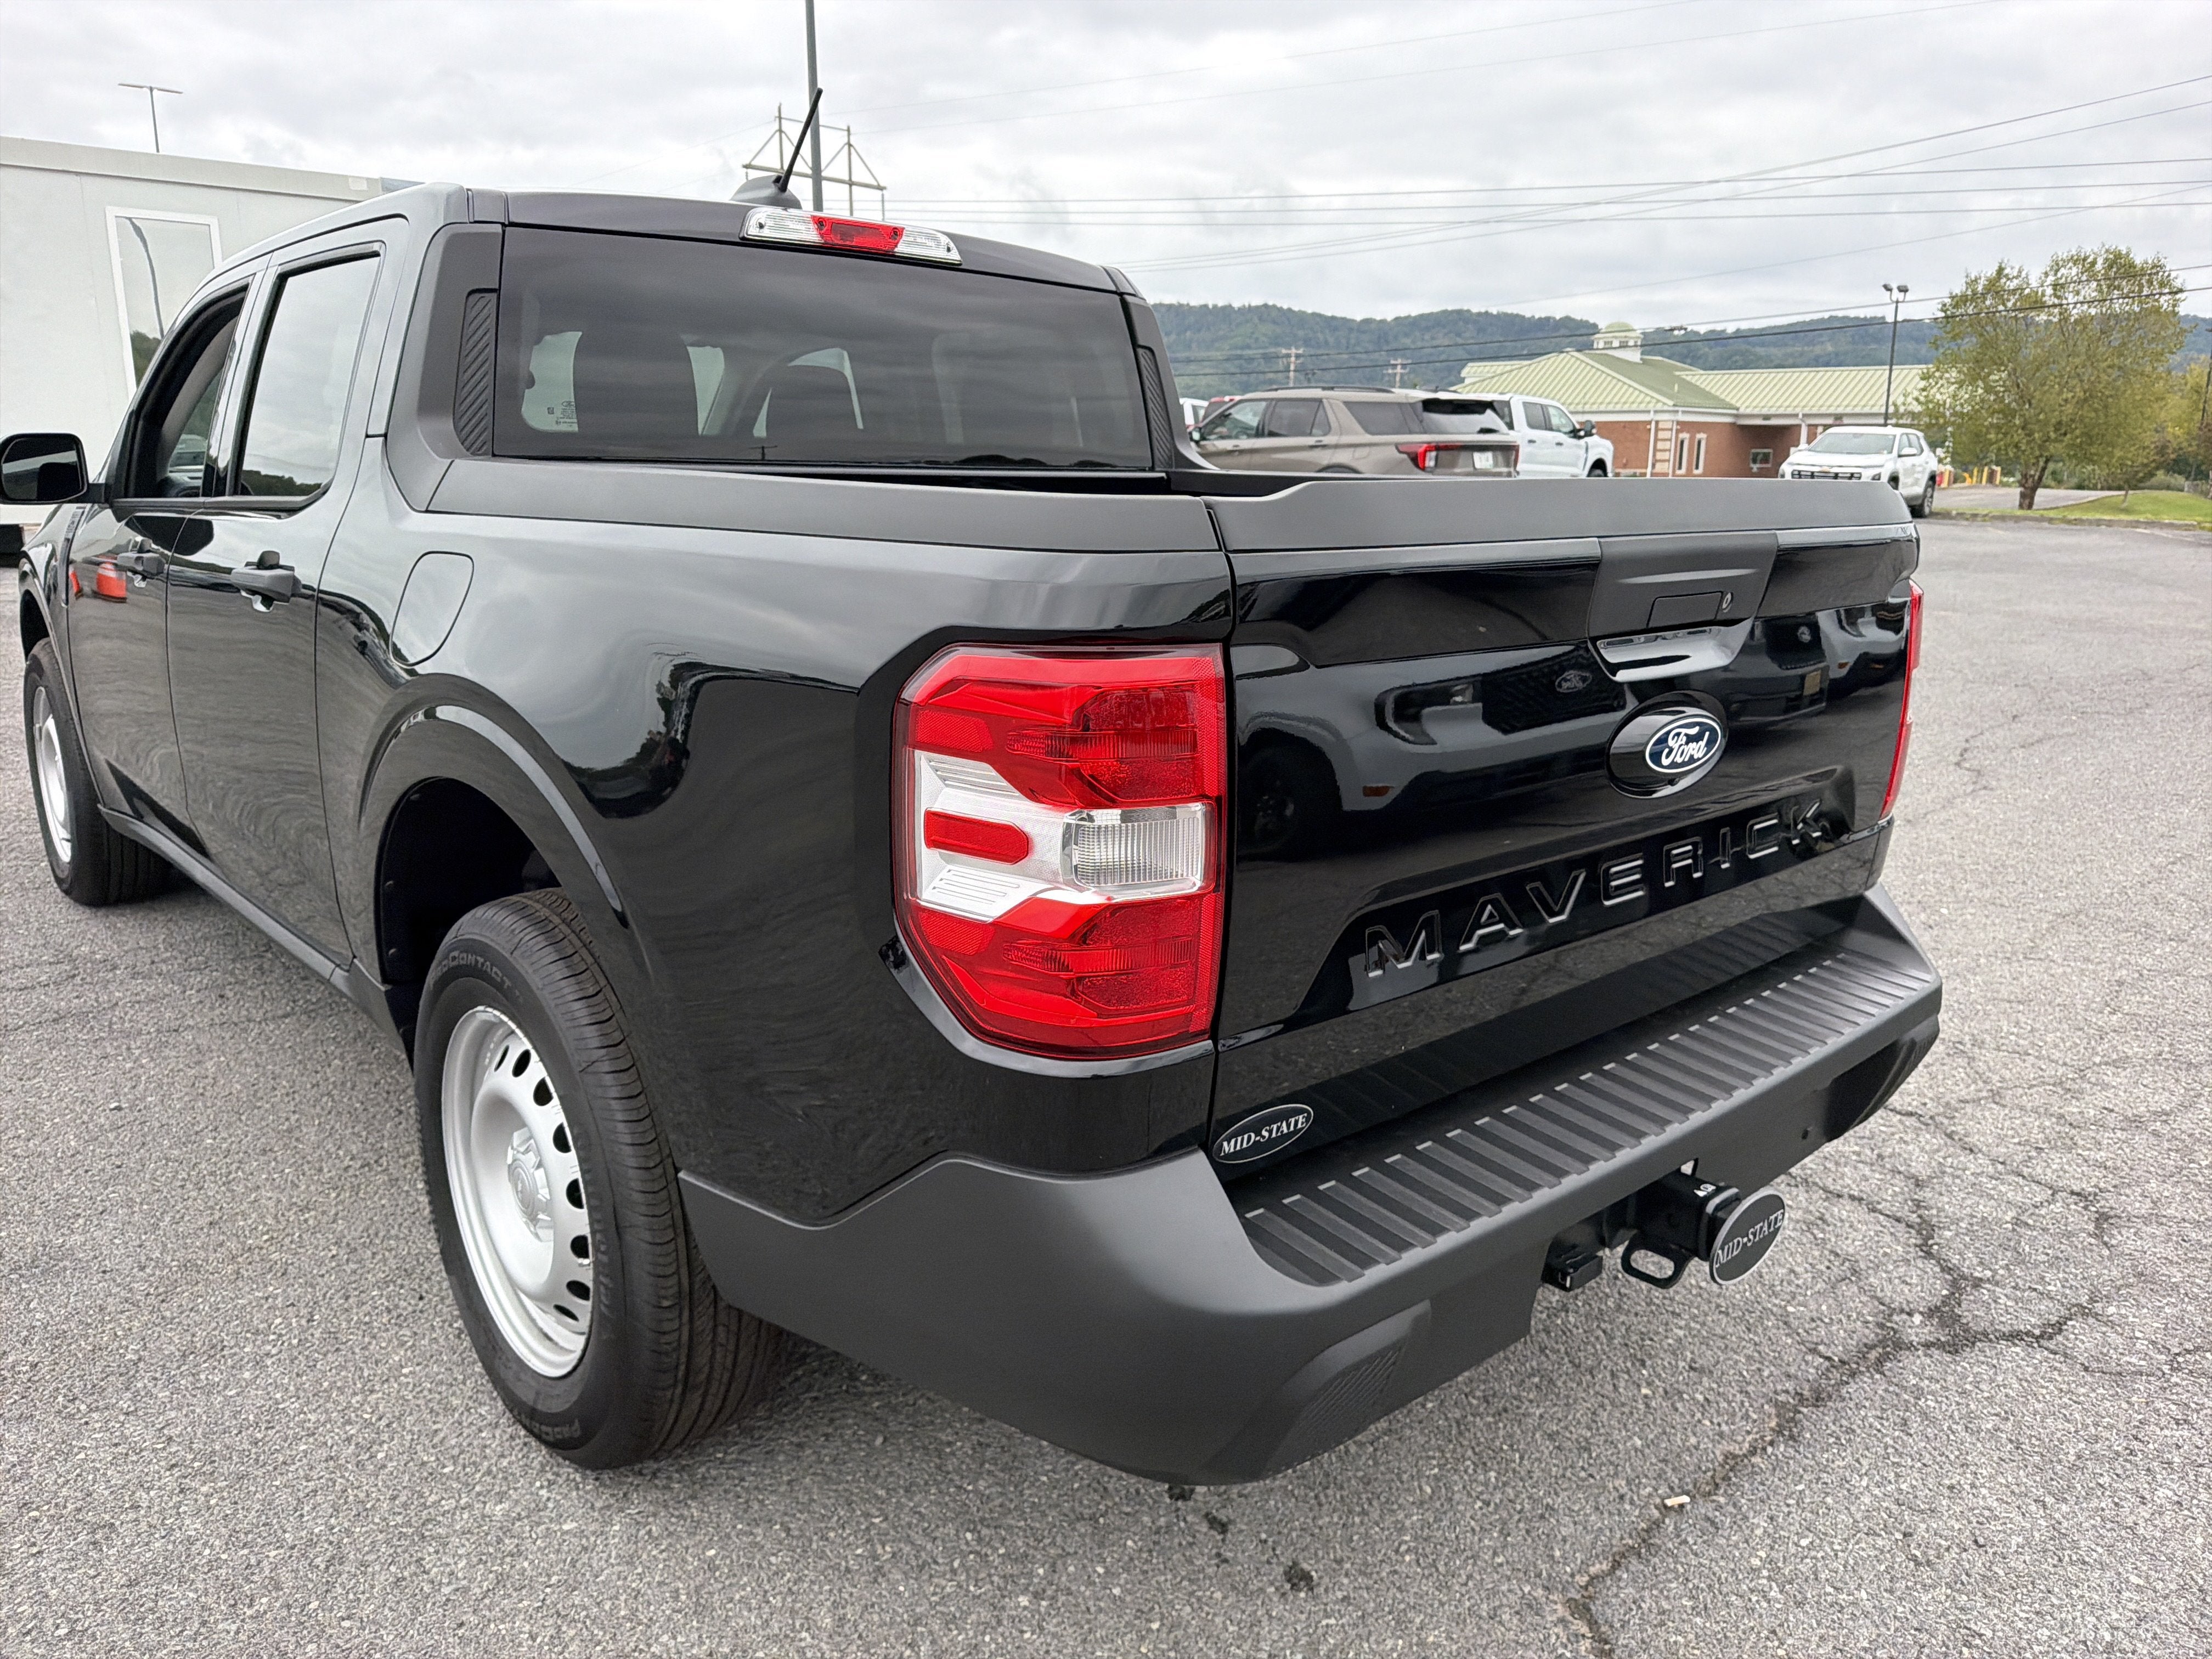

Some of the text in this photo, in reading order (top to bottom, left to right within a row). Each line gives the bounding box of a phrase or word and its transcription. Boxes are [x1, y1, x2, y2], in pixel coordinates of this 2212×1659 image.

[1661, 726, 1709, 766] Ford
[1364, 800, 1822, 978] MAVERICK
[1220, 1113, 1307, 1156] MID-STATE
[1716, 1209, 1784, 1268] MID-STATE
